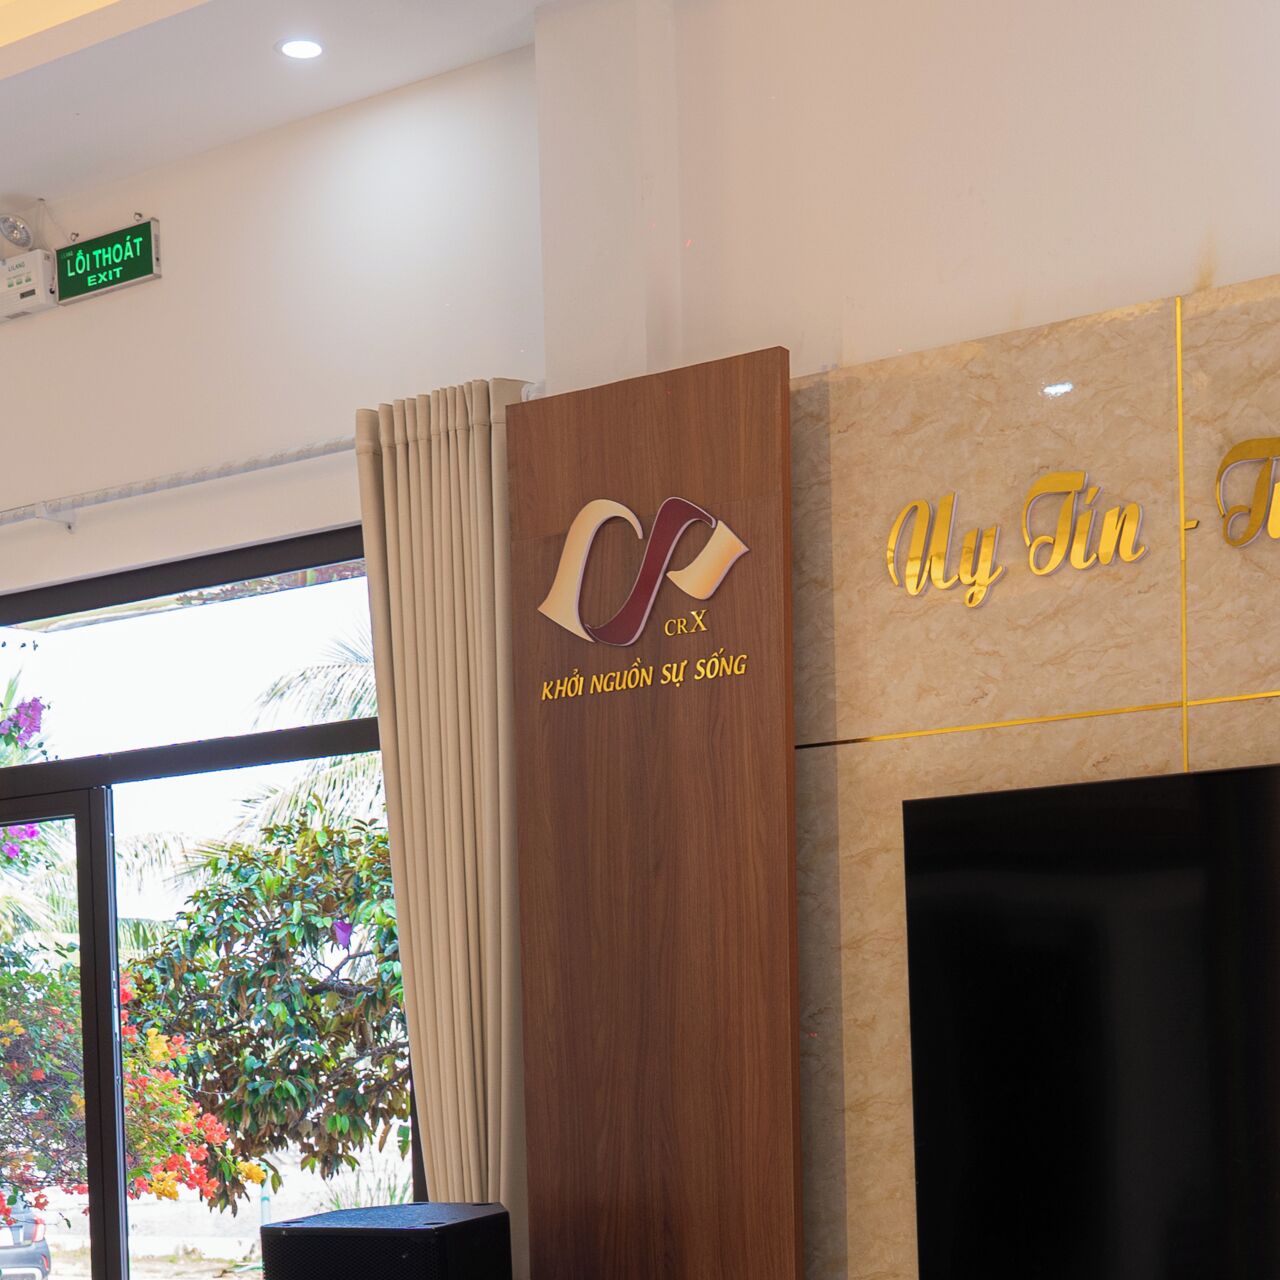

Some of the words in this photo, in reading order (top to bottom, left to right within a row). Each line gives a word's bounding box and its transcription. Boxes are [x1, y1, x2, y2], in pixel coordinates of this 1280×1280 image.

[92, 235, 143, 269] THOÁT
[87, 266, 123, 287] EXIT
[885, 489, 1004, 608] Uy
[1022, 470, 1148, 577] Tín
[664, 608, 708, 636] CRX
[541, 668, 584, 701] KHỞI
[589, 657, 654, 694] NGUỒN
[660, 659, 688, 687] SỰ
[694, 648, 749, 681] SỐNG
